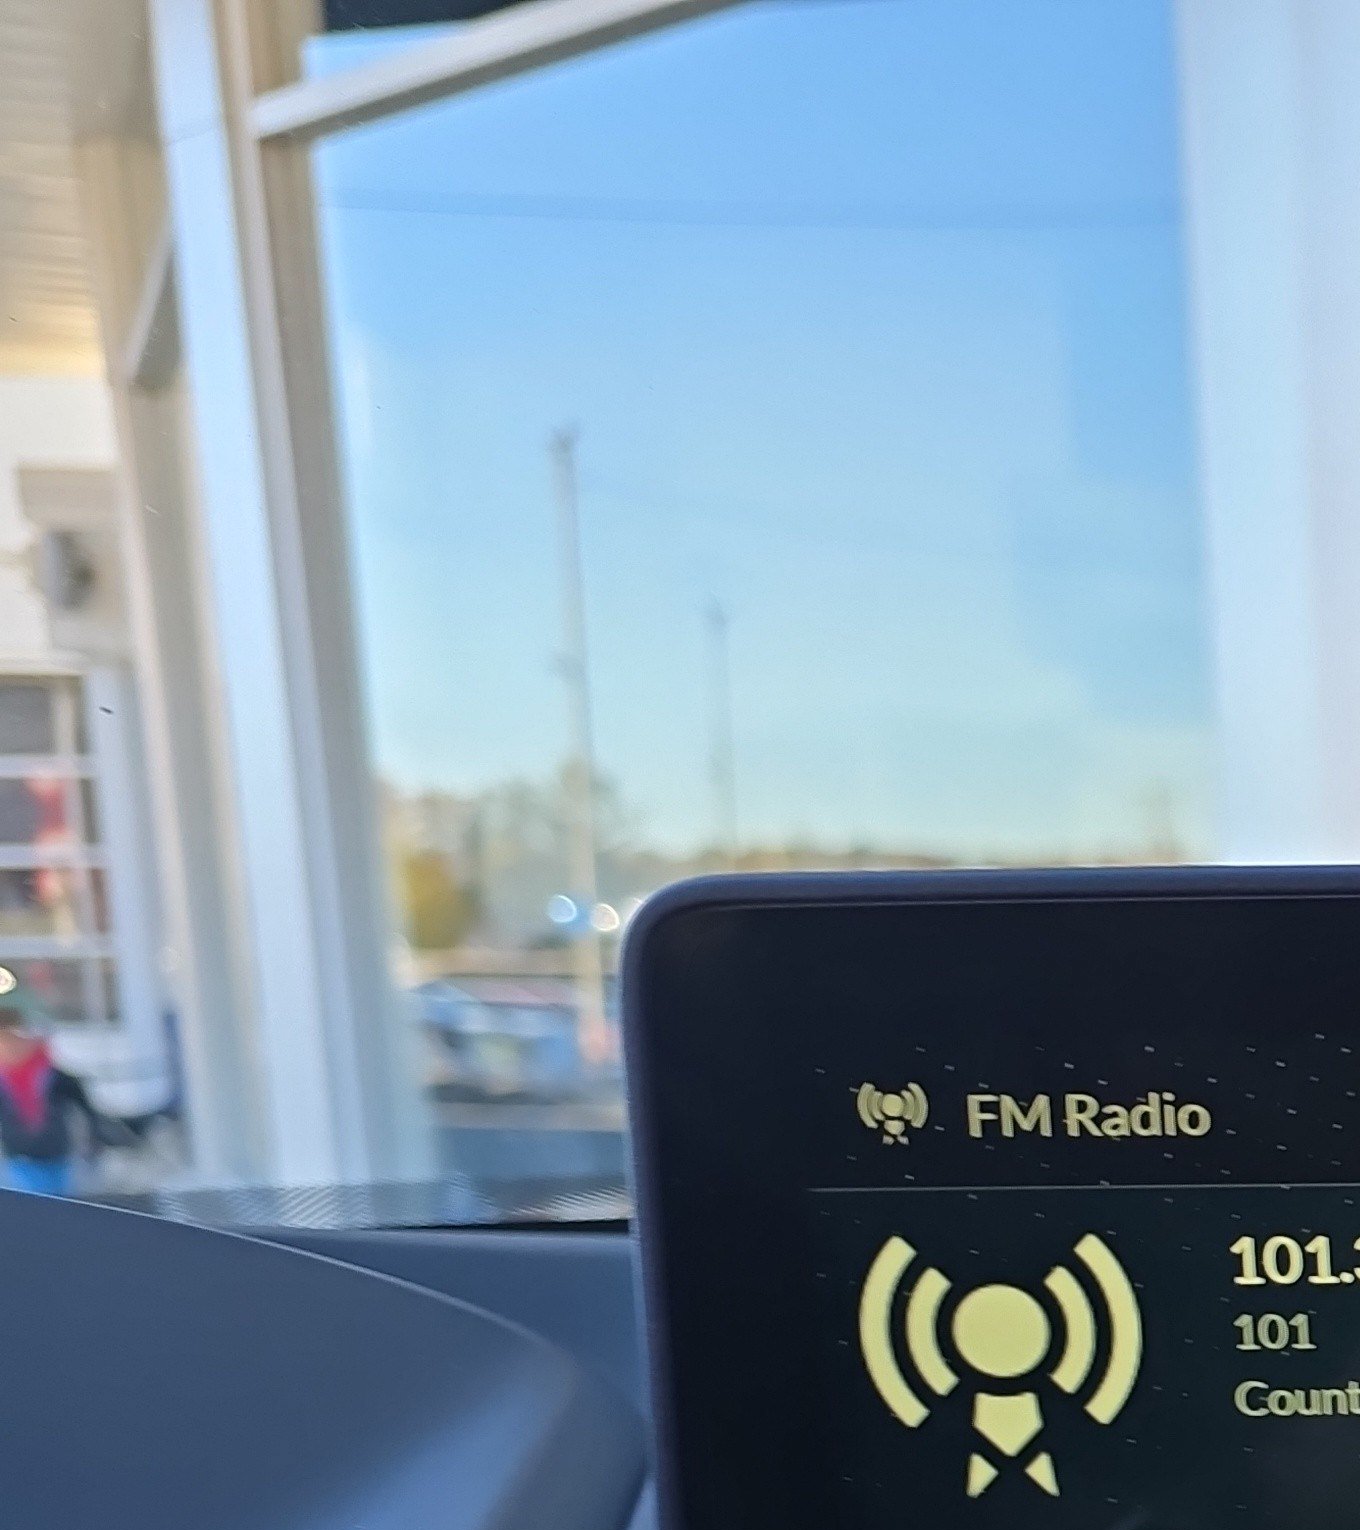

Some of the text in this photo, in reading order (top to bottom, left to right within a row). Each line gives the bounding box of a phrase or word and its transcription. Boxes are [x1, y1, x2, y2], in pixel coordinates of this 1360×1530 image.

[966, 1091, 1212, 1138] FM Radio
[1233, 1313, 1317, 1351] 101
